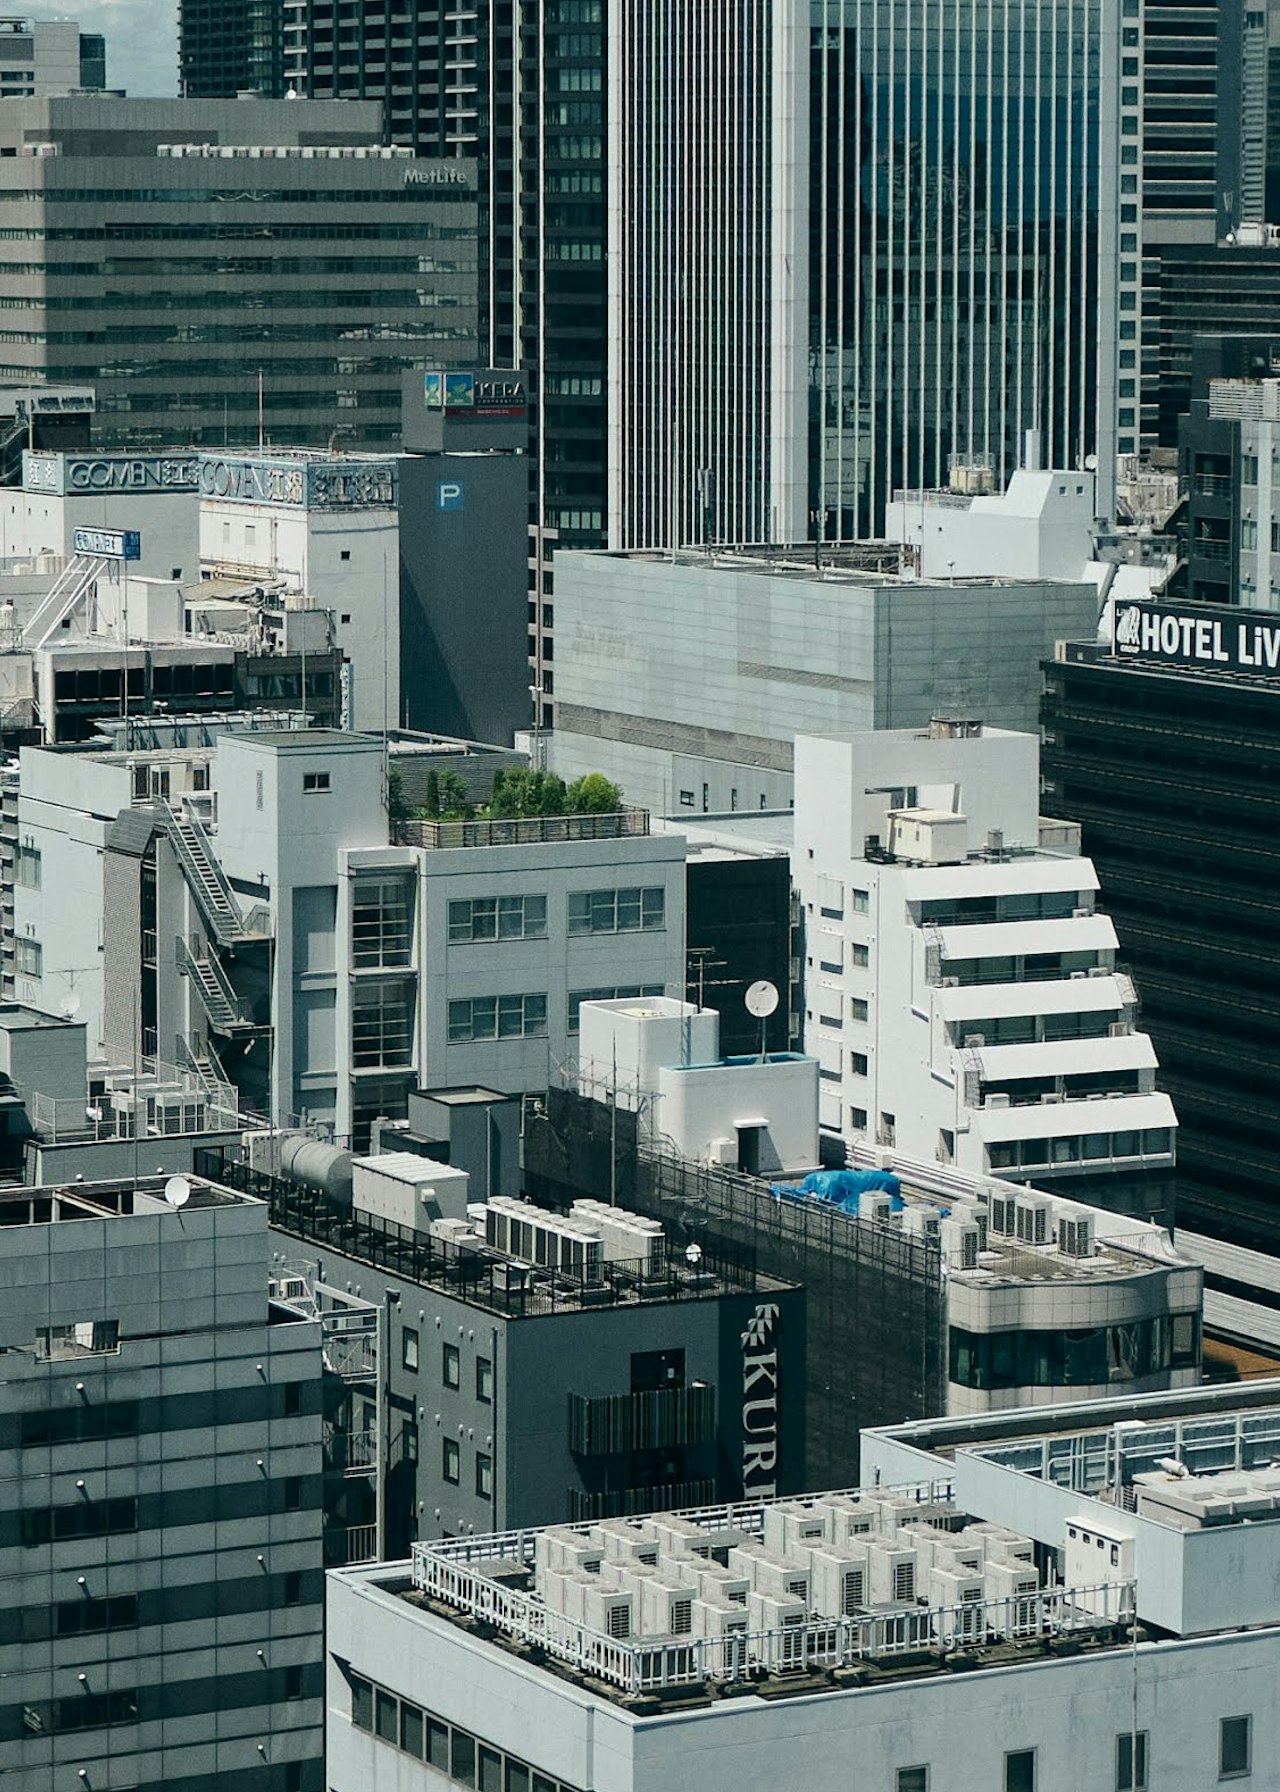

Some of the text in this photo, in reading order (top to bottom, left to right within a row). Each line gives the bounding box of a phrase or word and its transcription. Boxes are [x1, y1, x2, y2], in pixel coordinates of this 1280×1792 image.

[404, 166, 466, 183] MetLife
[441, 485, 460, 507] P
[1141, 612, 1229, 662] HOTEL
